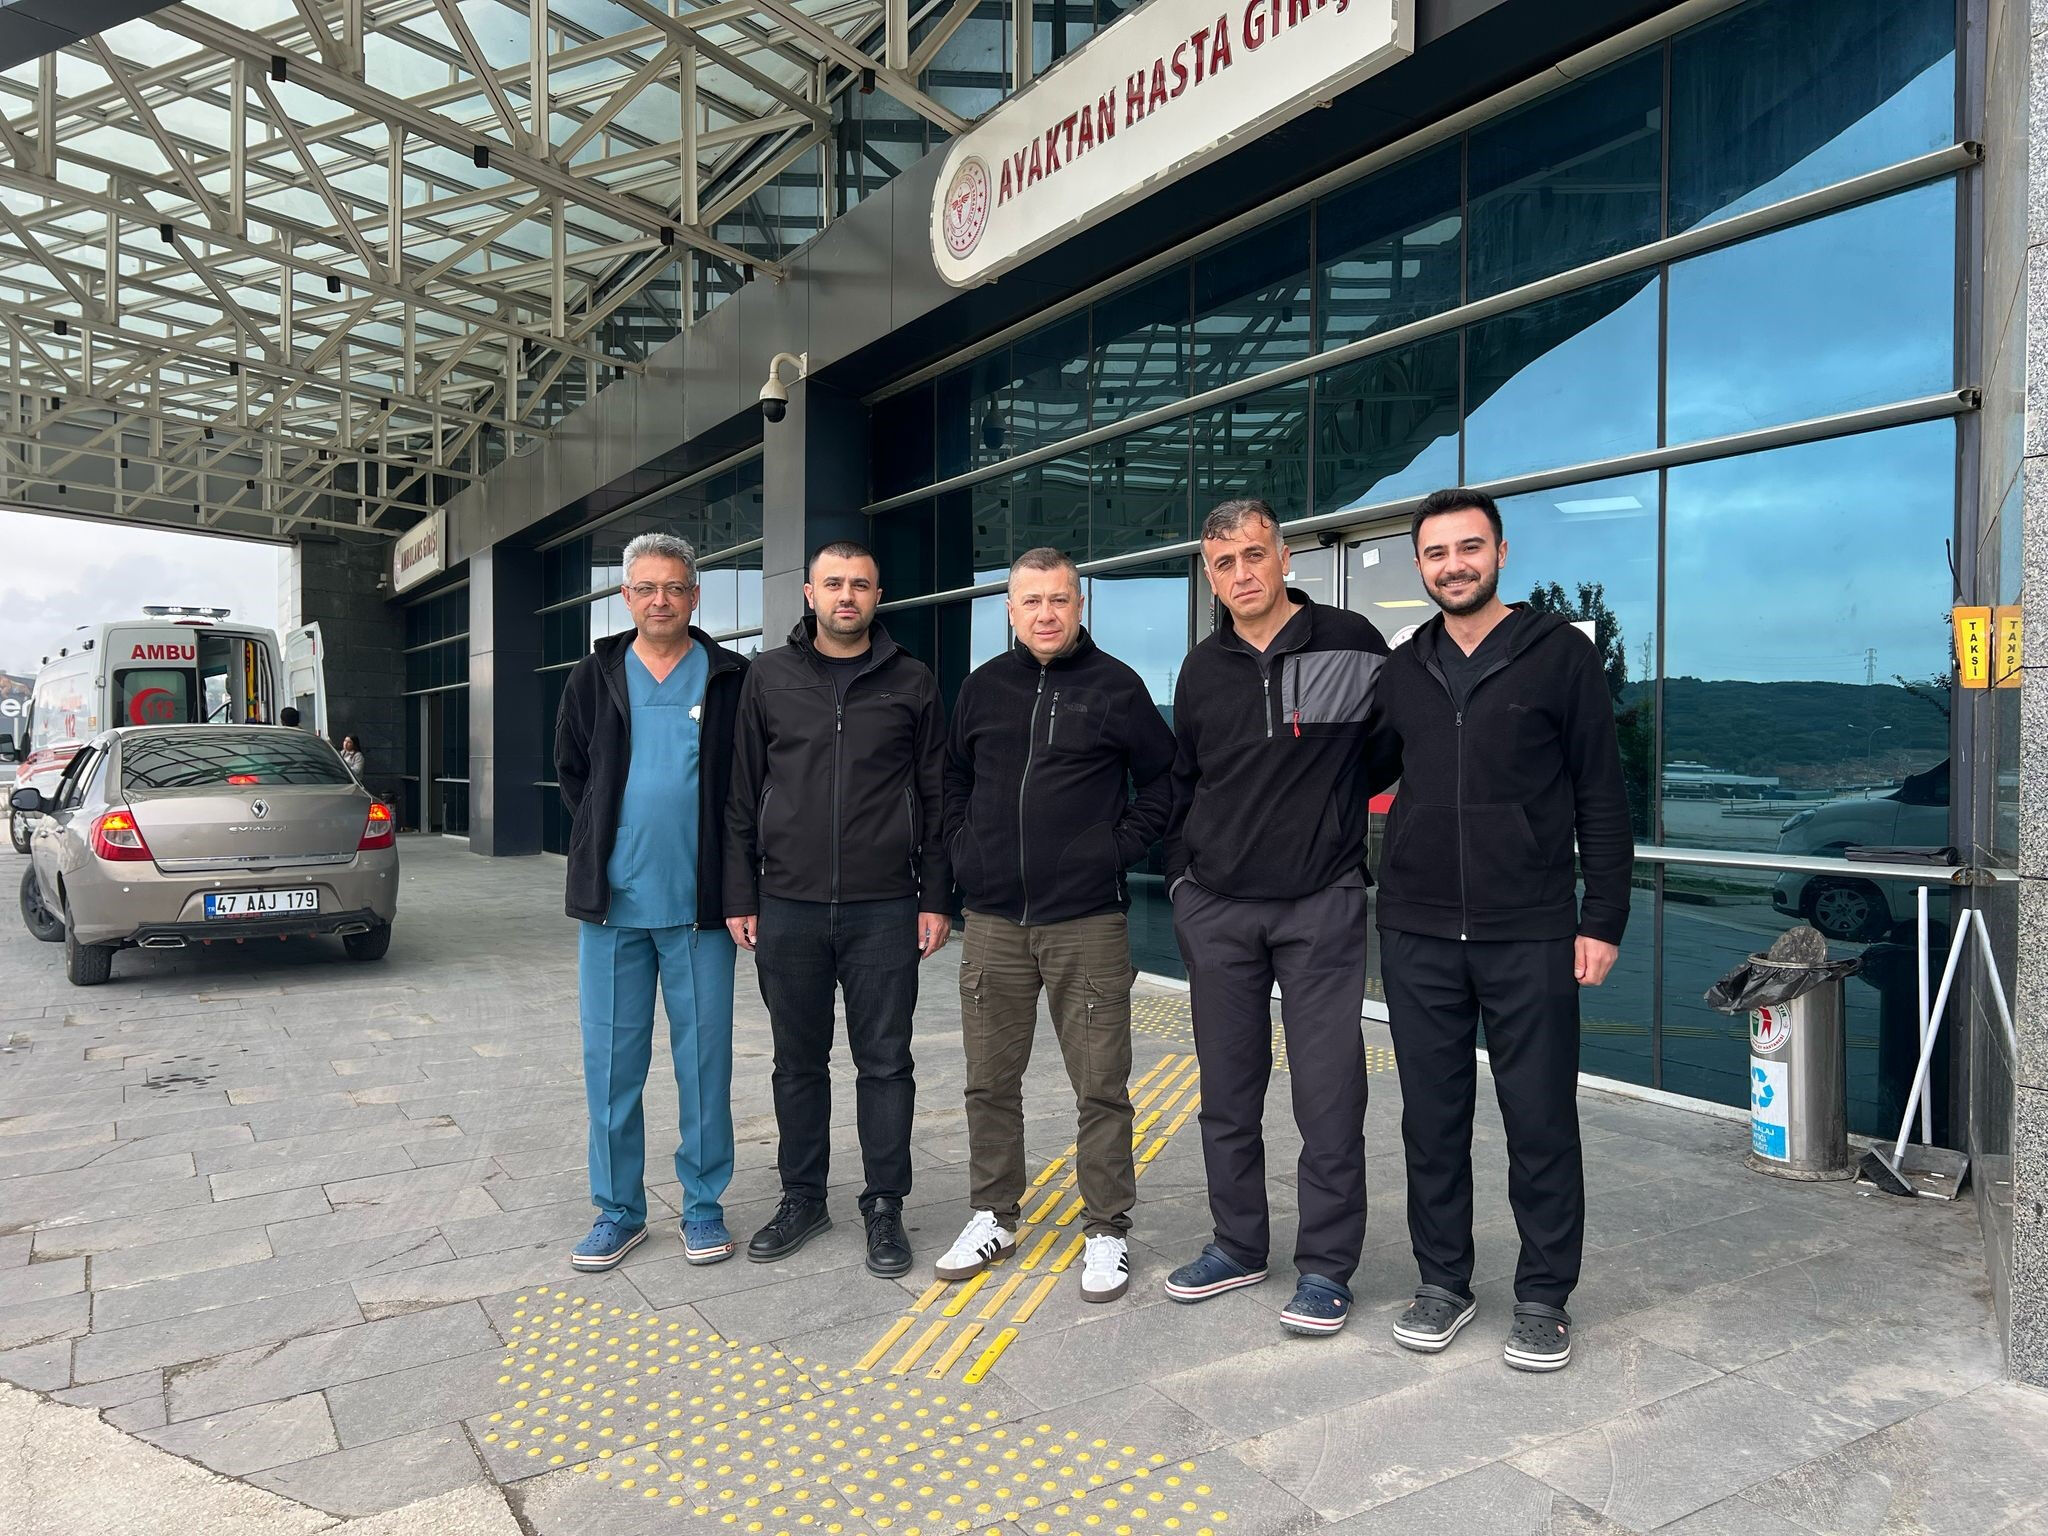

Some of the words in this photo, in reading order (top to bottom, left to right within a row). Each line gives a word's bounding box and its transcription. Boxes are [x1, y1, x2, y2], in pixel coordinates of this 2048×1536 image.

[998, 86, 1117, 207] AYAKTAN
[1126, 13, 1233, 128] HASTA
[131, 645, 195, 660] AMBU
[1969, 622, 1979, 676] TAKSİ
[146, 701, 174, 718] 112
[65, 713, 76, 737] 112
[217, 897, 236, 912] 47
[247, 894, 276, 911] AAJ
[287, 892, 314, 908] 179
